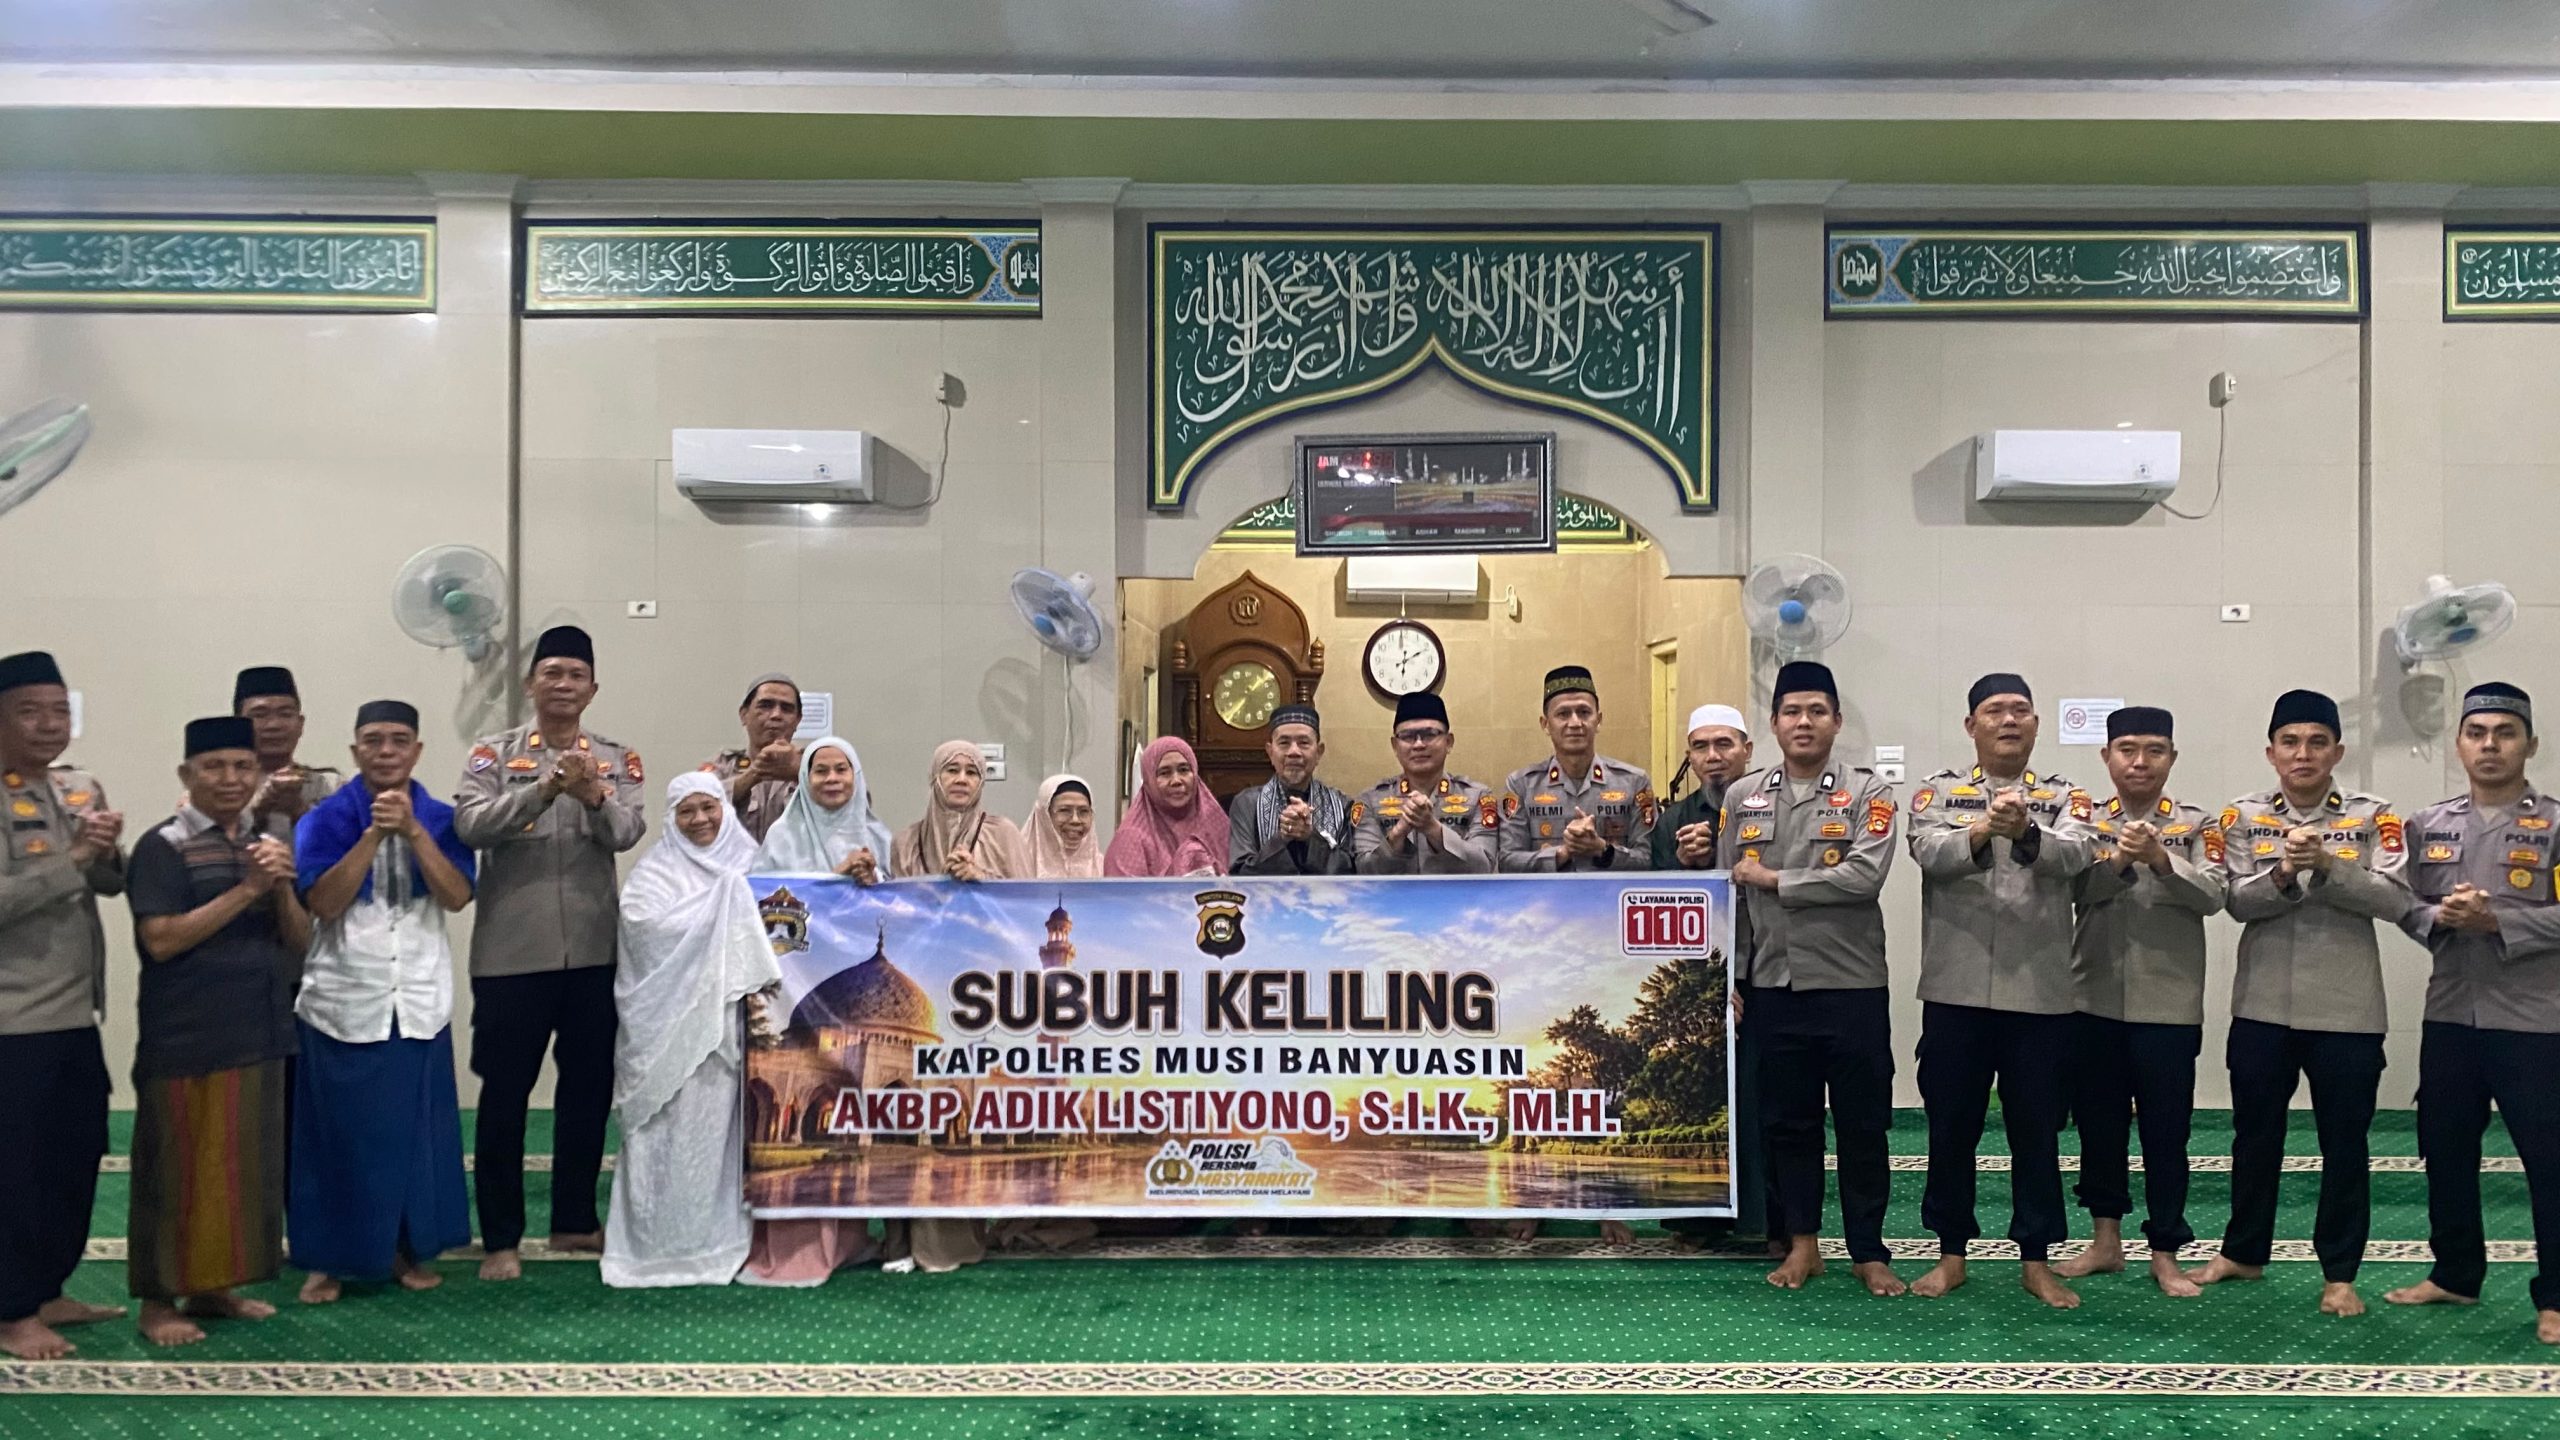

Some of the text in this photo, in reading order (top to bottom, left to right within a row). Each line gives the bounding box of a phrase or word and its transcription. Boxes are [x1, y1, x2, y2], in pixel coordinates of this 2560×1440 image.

[1528, 805, 1563, 817] HELMI
[1596, 804, 1631, 816] POLRI
[1816, 808, 1853, 818] POLRI
[2322, 831, 2369, 843] POLRI
[1639, 895, 1704, 905] LAYANAN POLISI
[1632, 909, 1701, 942] 110
[951, 970, 1495, 1032] SUBUH KELILING
[917, 1046, 1523, 1075] KAPOLRES MUSI BANYUASIN
[833, 1090, 1617, 1137] AKBP ADIK LISTIYONO, S.I.K., M.H.
[1188, 1143, 1252, 1160] POLISI
[1200, 1161, 1257, 1171] BERSAMA
[1195, 1173, 1311, 1187] MASYARAKAT
